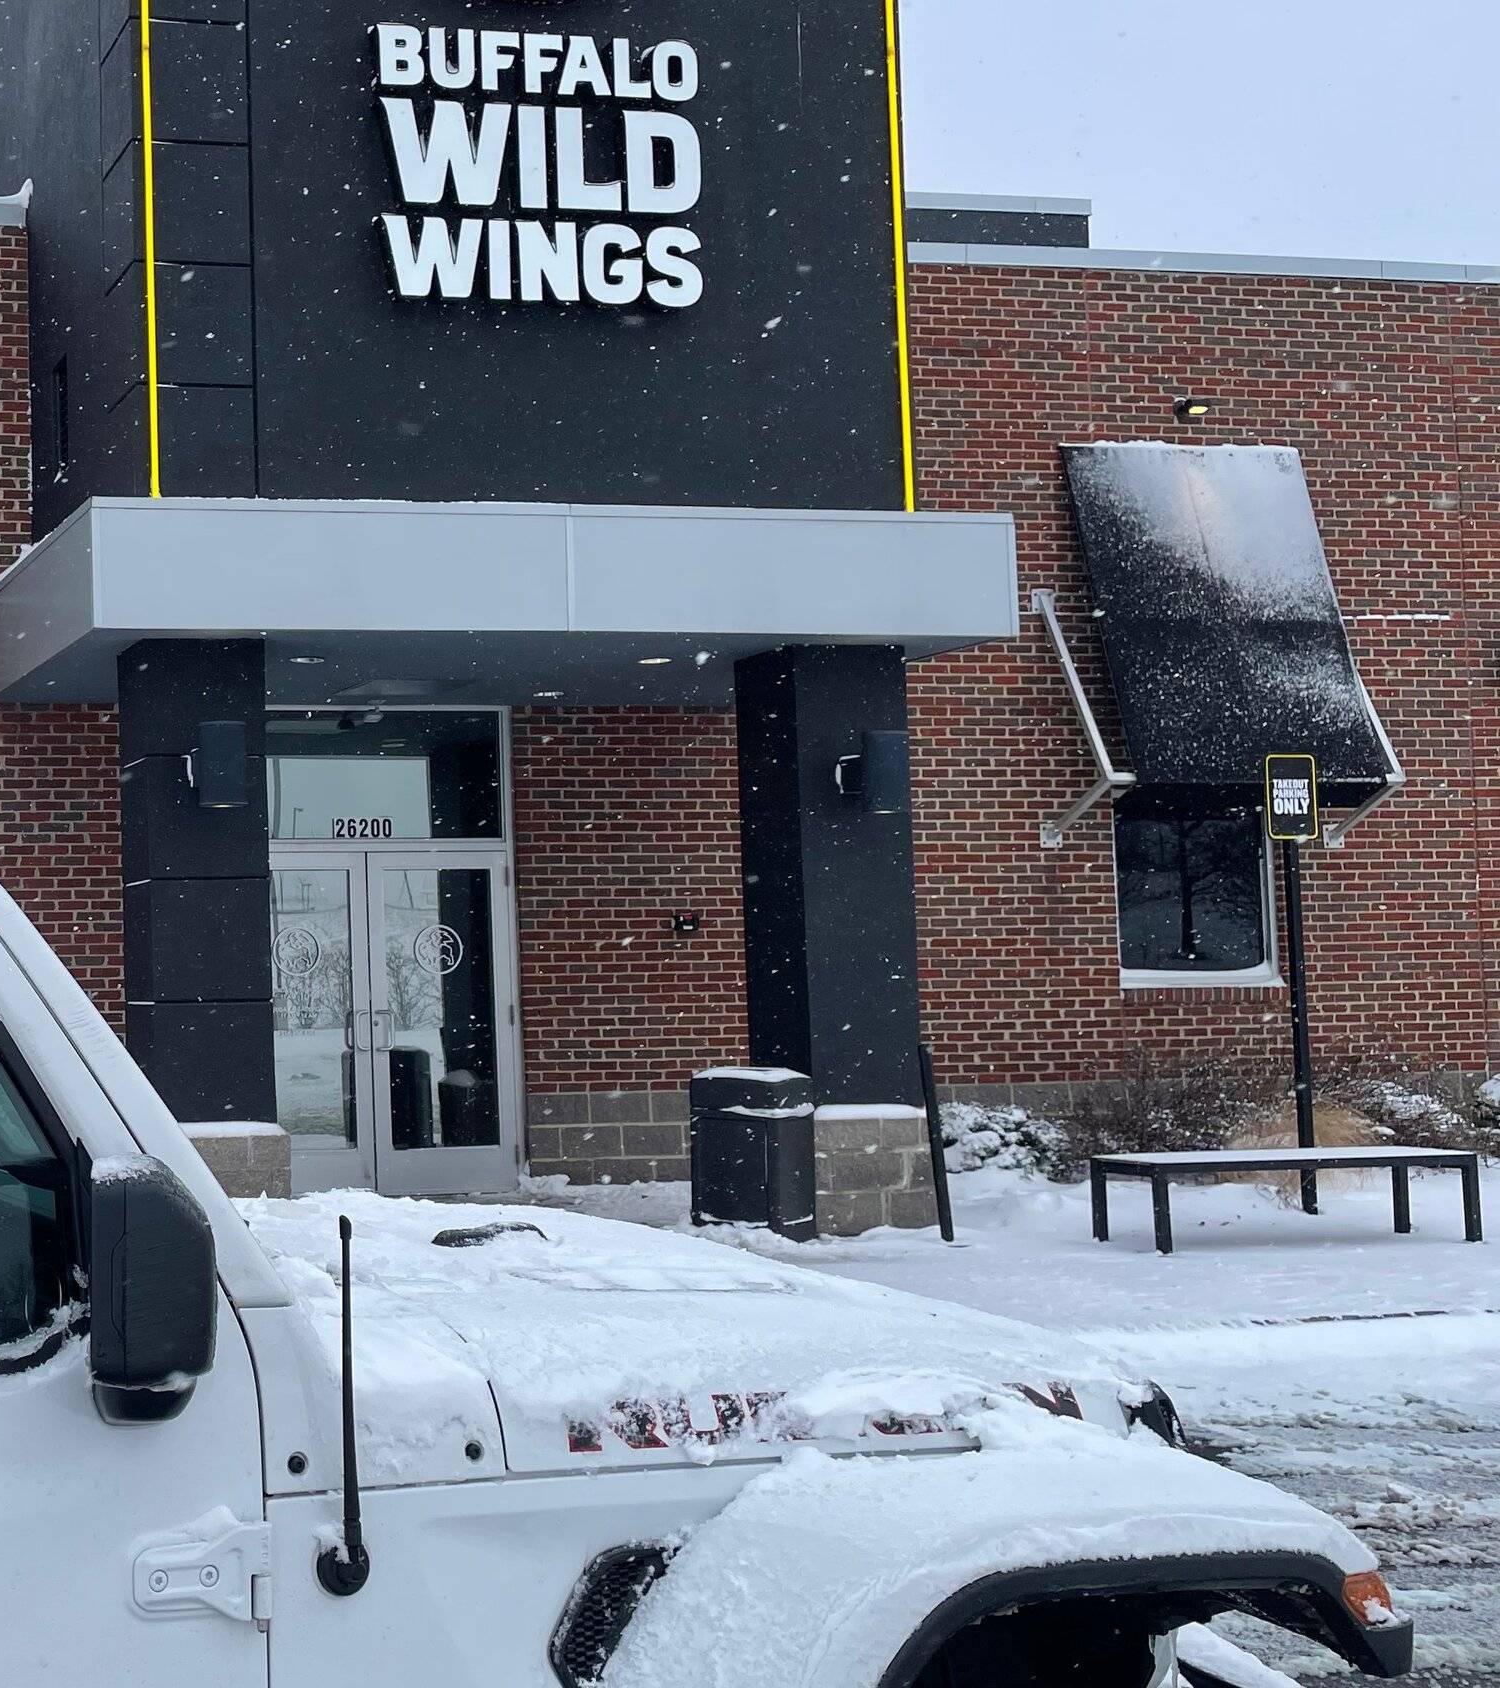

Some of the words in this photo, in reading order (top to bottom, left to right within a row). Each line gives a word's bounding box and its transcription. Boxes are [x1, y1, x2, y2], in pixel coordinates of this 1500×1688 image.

[374, 23, 699, 101] BUFFALO
[380, 97, 701, 213] WILD
[381, 213, 703, 307] WINGS
[1273, 779, 1309, 789] TAKEOUT
[1273, 788, 1309, 798] PARKING
[1273, 798, 1310, 815] ONLY
[335, 818, 392, 838] 26200
